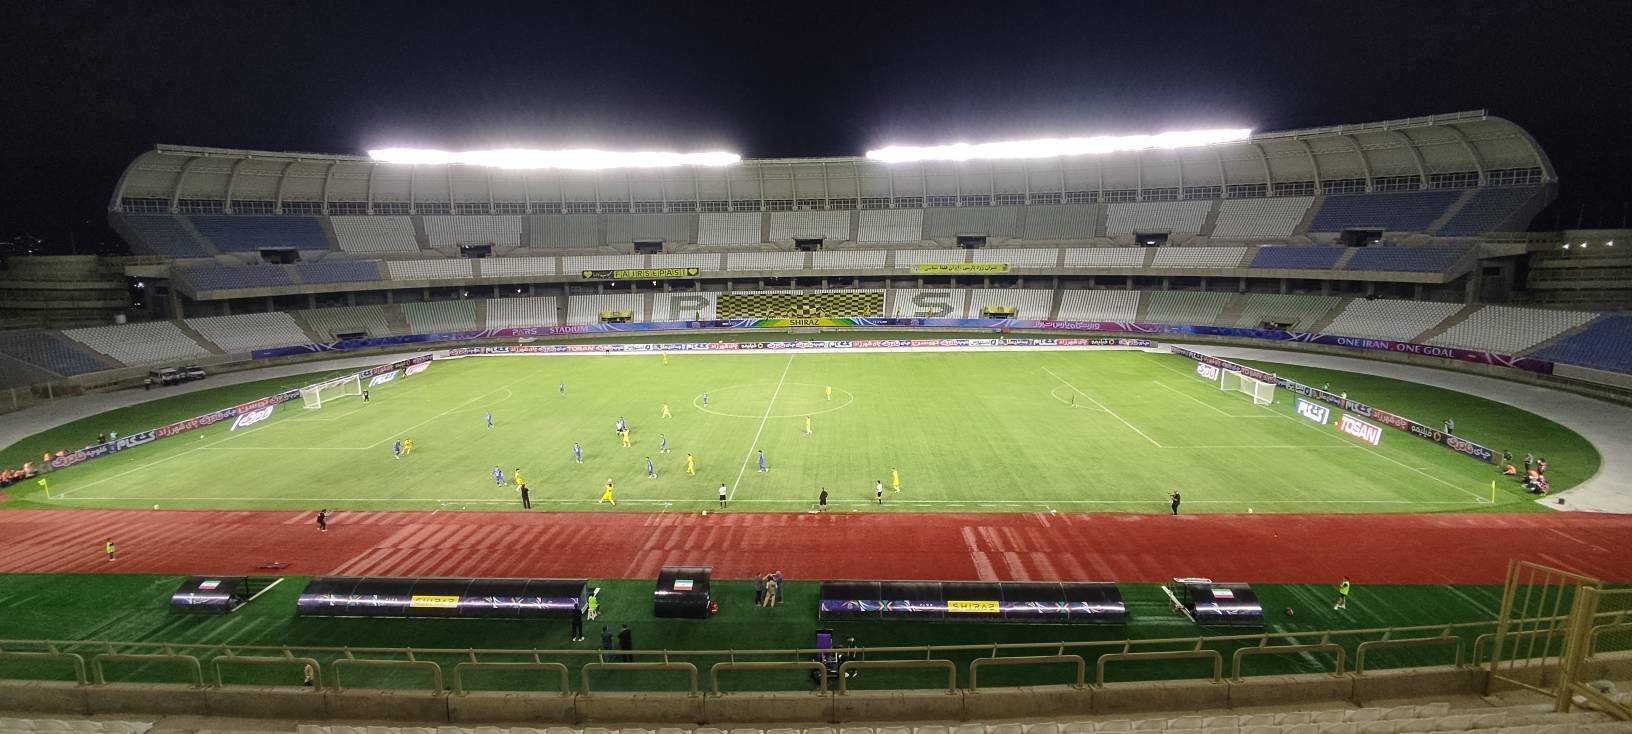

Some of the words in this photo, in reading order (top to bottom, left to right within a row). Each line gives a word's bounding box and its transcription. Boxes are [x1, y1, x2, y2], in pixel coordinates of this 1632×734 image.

[512, 328, 538, 336] PARS
[549, 325, 590, 334] STADIUM
[1337, 337, 1362, 346] ONE
[1362, 339, 1389, 349] IRAN
[1396, 343, 1423, 353] ONE
[1423, 346, 1456, 358] GOAL
[1342, 416, 1378, 445] TOSAN
